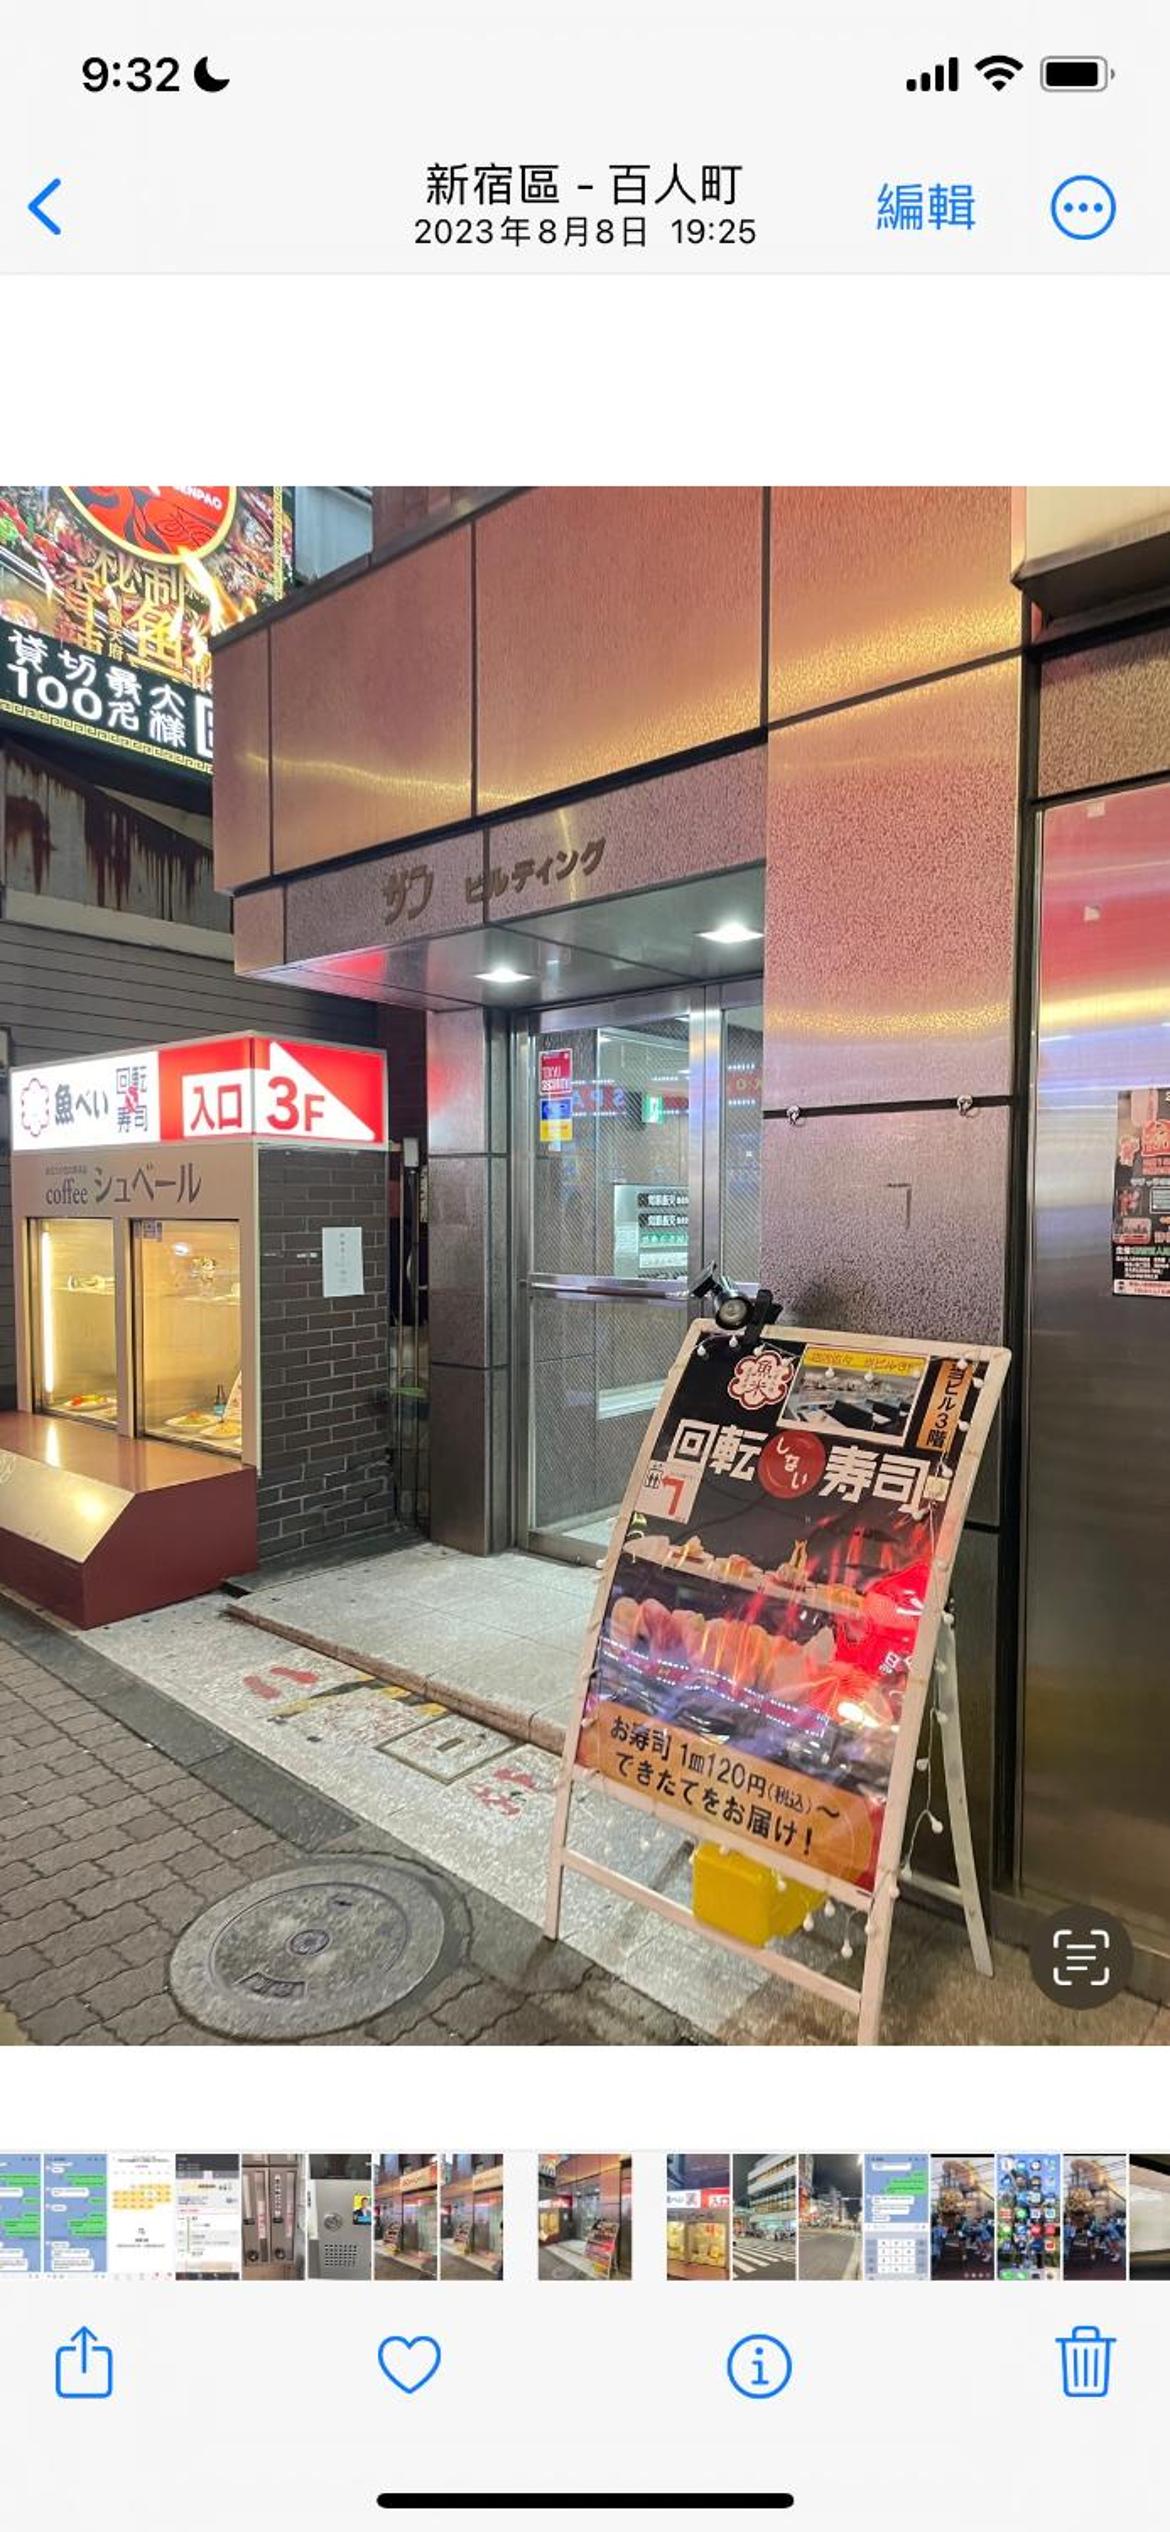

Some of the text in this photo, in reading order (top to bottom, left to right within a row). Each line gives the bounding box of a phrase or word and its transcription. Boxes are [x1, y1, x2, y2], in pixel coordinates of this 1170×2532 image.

[54, 1083, 110, 1126] 魚べい
[190, 1083, 243, 1131] 入口
[267, 1076, 326, 1132] 3F
[46, 1163, 202, 1205] coffee シュベール
[924, 1360, 972, 1450] 当ビル3階
[666, 1419, 932, 1514] 回転 しない 寿司
[610, 1715, 672, 1761] お寿司
[615, 1750, 813, 1856] できたてをお届け!
